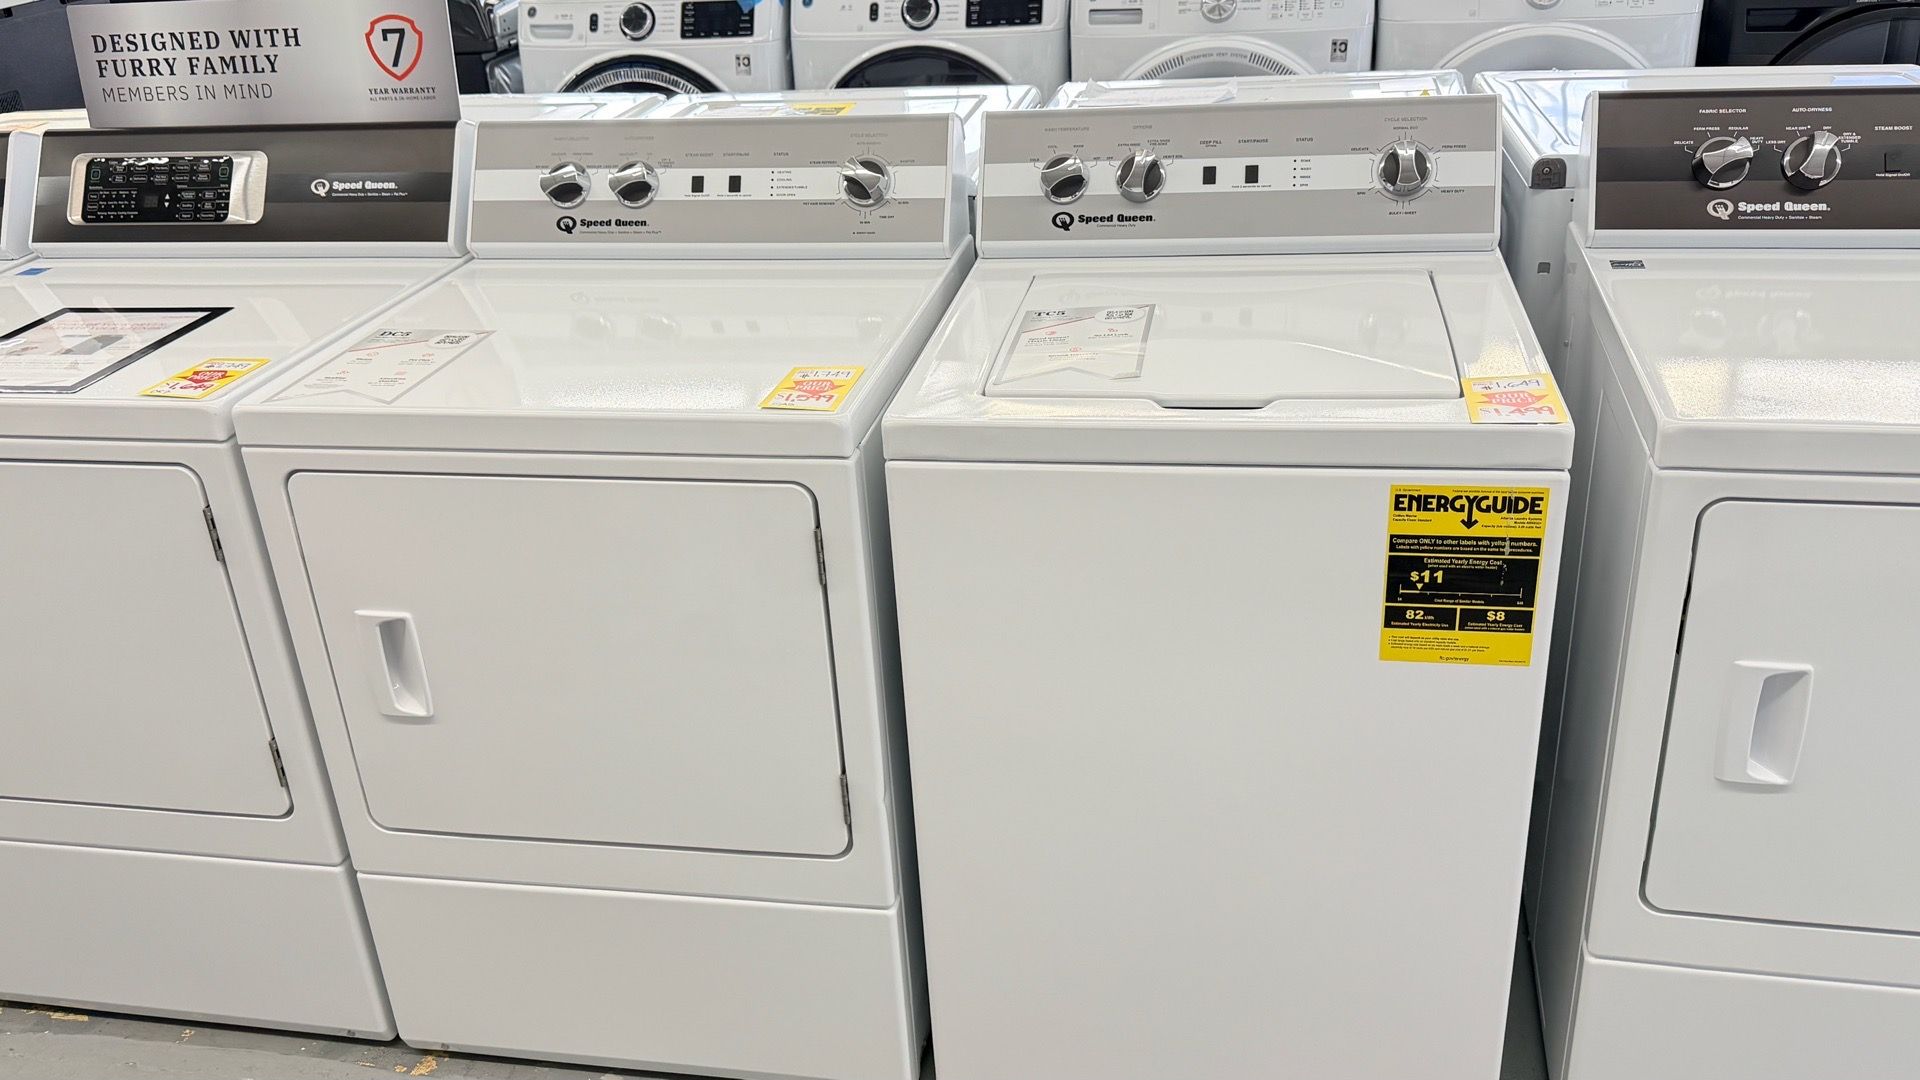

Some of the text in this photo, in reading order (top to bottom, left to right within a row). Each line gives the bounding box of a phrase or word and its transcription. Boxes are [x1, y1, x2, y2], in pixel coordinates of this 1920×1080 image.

[91, 27, 301, 54] DESIGNED WITH
[381, 28, 405, 68] 7
[96, 54, 279, 79] FURRY FAMILY
[102, 83, 273, 103] MEMBERS IN MIND
[332, 181, 362, 191] Speed
[1738, 202, 1780, 214] Speed
[580, 219, 611, 228] Speed
[1078, 214, 1113, 225] Speed
[1494, 391, 1529, 399] OUR
[1394, 494, 1544, 515] ENERGYGUIDE
[1410, 570, 1444, 583] $11
[1406, 610, 1424, 620] 82
[1486, 611, 1505, 622] $8
